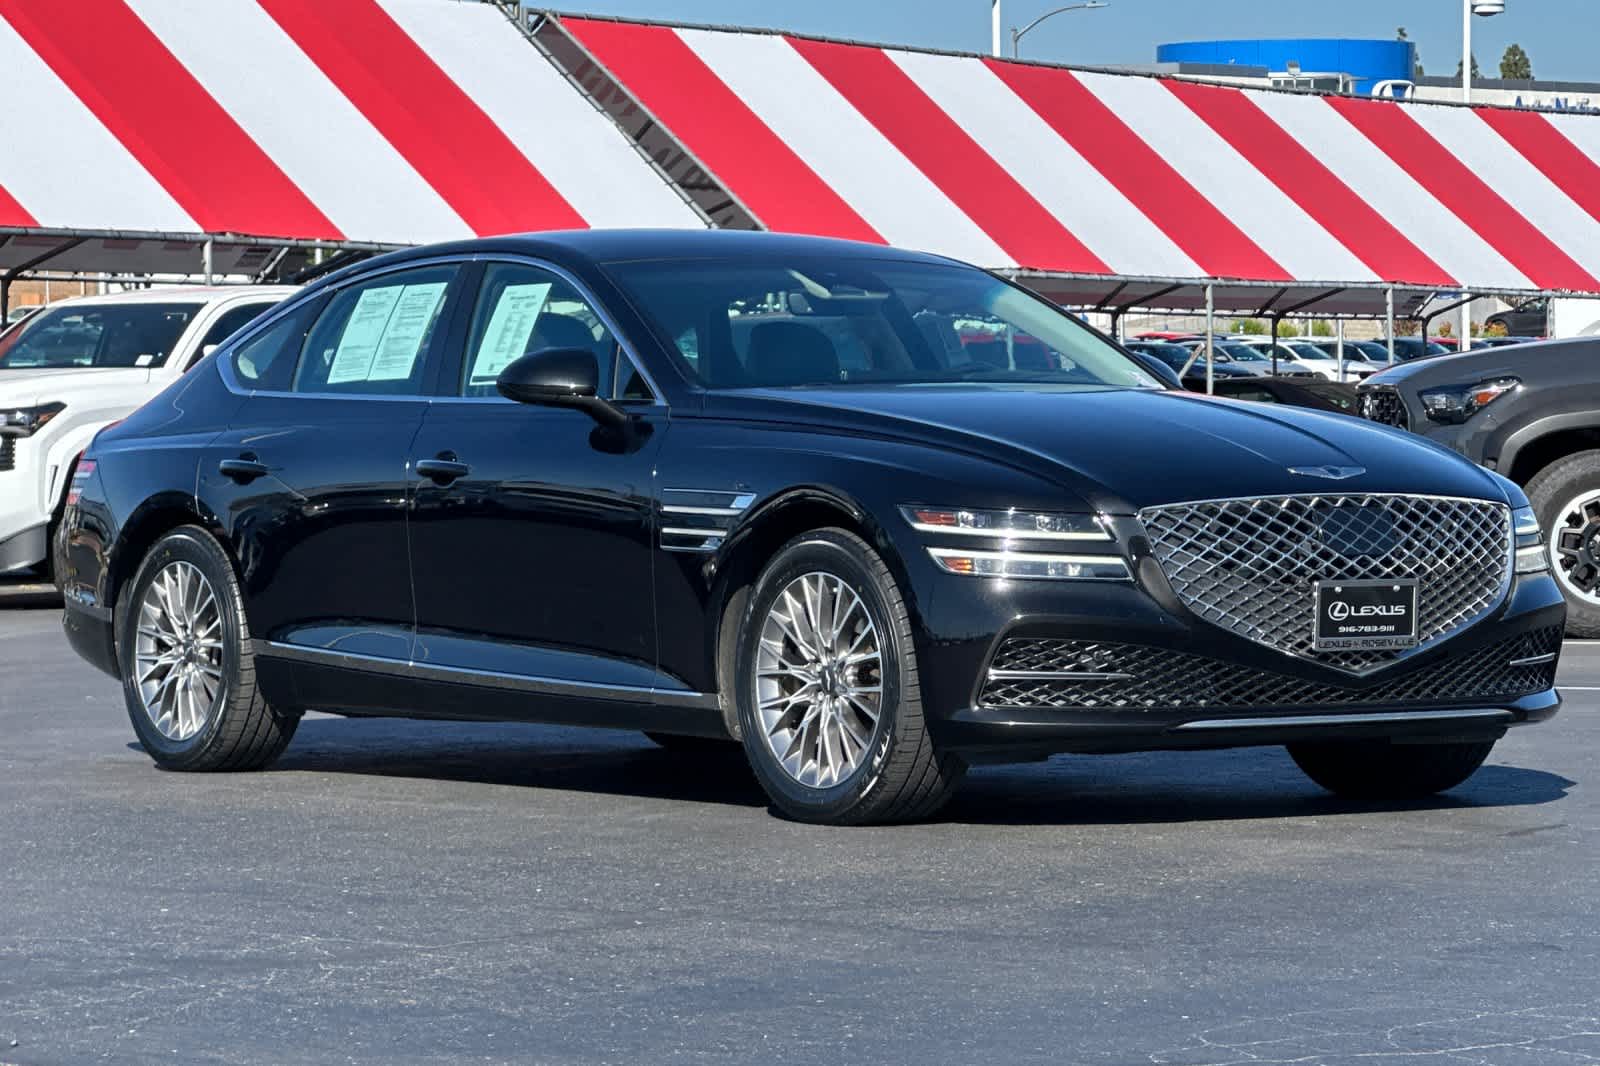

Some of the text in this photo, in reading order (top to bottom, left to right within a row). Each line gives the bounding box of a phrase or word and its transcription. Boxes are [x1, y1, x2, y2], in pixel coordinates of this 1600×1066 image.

[1351, 605, 1406, 616] LEXUS
[1338, 625, 1395, 633] 916-783-9111
[1319, 640, 1352, 649] LEXUS
[1361, 639, 1415, 648] ROSEVILLE
